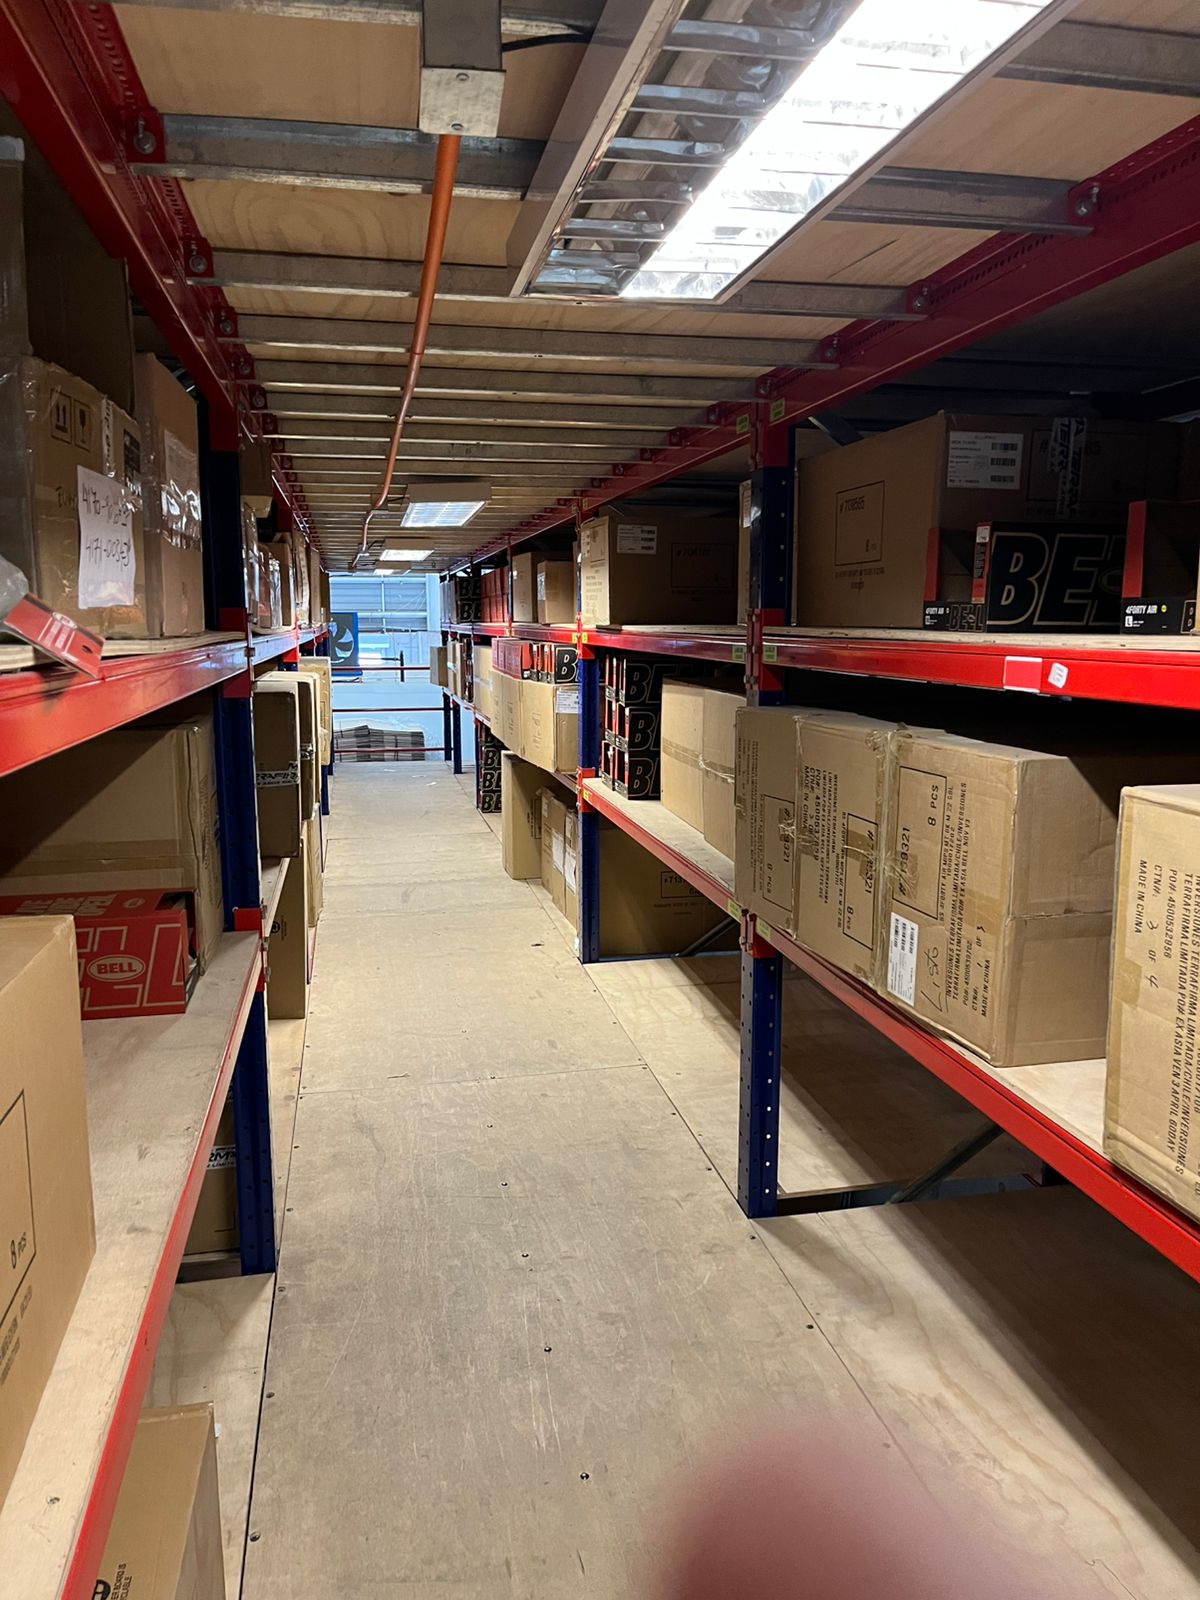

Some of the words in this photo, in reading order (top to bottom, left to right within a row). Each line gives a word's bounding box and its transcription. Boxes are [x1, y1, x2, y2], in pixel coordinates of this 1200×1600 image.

[1125, 605, 1147, 614] 4FORTY
[1147, 605, 1158, 614] AIR
[555, 647, 580, 682] B
[803, 792, 809, 802] IN
[930, 784, 939, 809] PCS
[927, 816, 936, 827] 8
[952, 782, 967, 898] LIMITADA/CHILE/INVERSIONES
[1138, 859, 1147, 888] MADE
[1152, 864, 1162, 897] CTN#:
[1136, 891, 1145, 901] IN
[1181, 873, 1193, 939] TERRAFIRMA
[1191, 875, 1200, 947] INVERSIONES
[949, 899, 957, 945] TERRAFIRMA
[1134, 902, 1144, 933] CHINA
[955, 917, 963, 954] LIMITADA
[976, 937, 982, 947] OF
[96, 962, 137, 975] BELL
[1148, 949, 1156, 963] OF
[1178, 941, 1189, 990] LIMITADA
[946, 948, 955, 997] INVERSIONES
[952, 954, 961, 1000] TERRAFIRMA
[1187, 950, 1200, 1016] TERRAFIRMA
[1175, 1017, 1185, 1032] EX
[1173, 1031, 1183, 1056] ASIA
[1171, 1057, 1182, 1079] VEN
[1171, 1079, 1180, 1087] 3
[1169, 1087, 1179, 1117] APRIL
[1175, 1017, 1196, 1175] LIMITADA/CHILE/INVERSIONES
[10, 1239, 17, 1269] 8
[113, 1570, 125, 1590] BOARD
